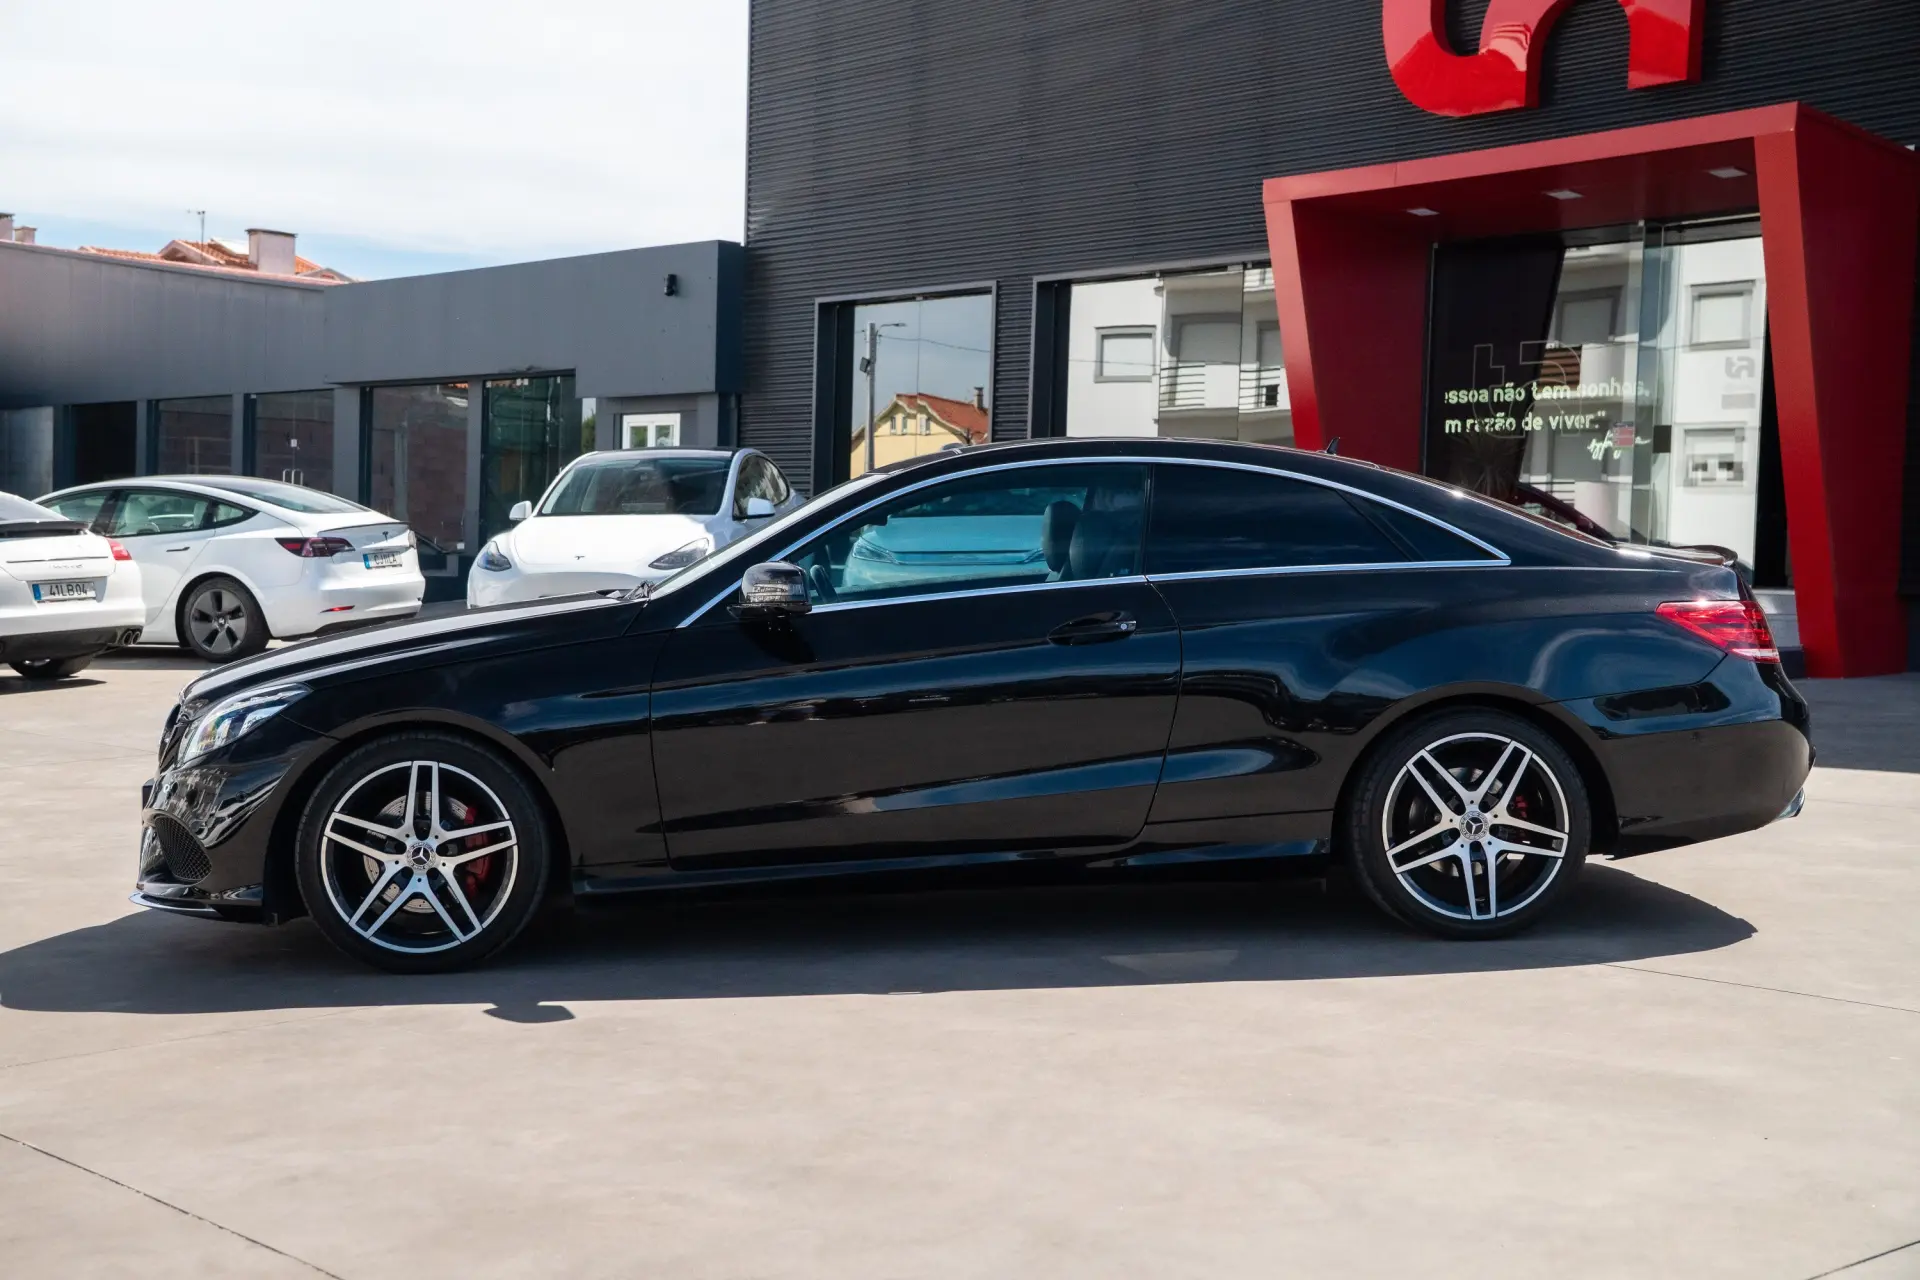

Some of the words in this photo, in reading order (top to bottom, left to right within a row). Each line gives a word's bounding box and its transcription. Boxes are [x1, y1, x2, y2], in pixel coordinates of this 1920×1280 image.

[1493, 381, 1526, 402] não
[1532, 381, 1570, 400] tem
[1465, 412, 1517, 433] razão
[1521, 411, 1543, 431] de
